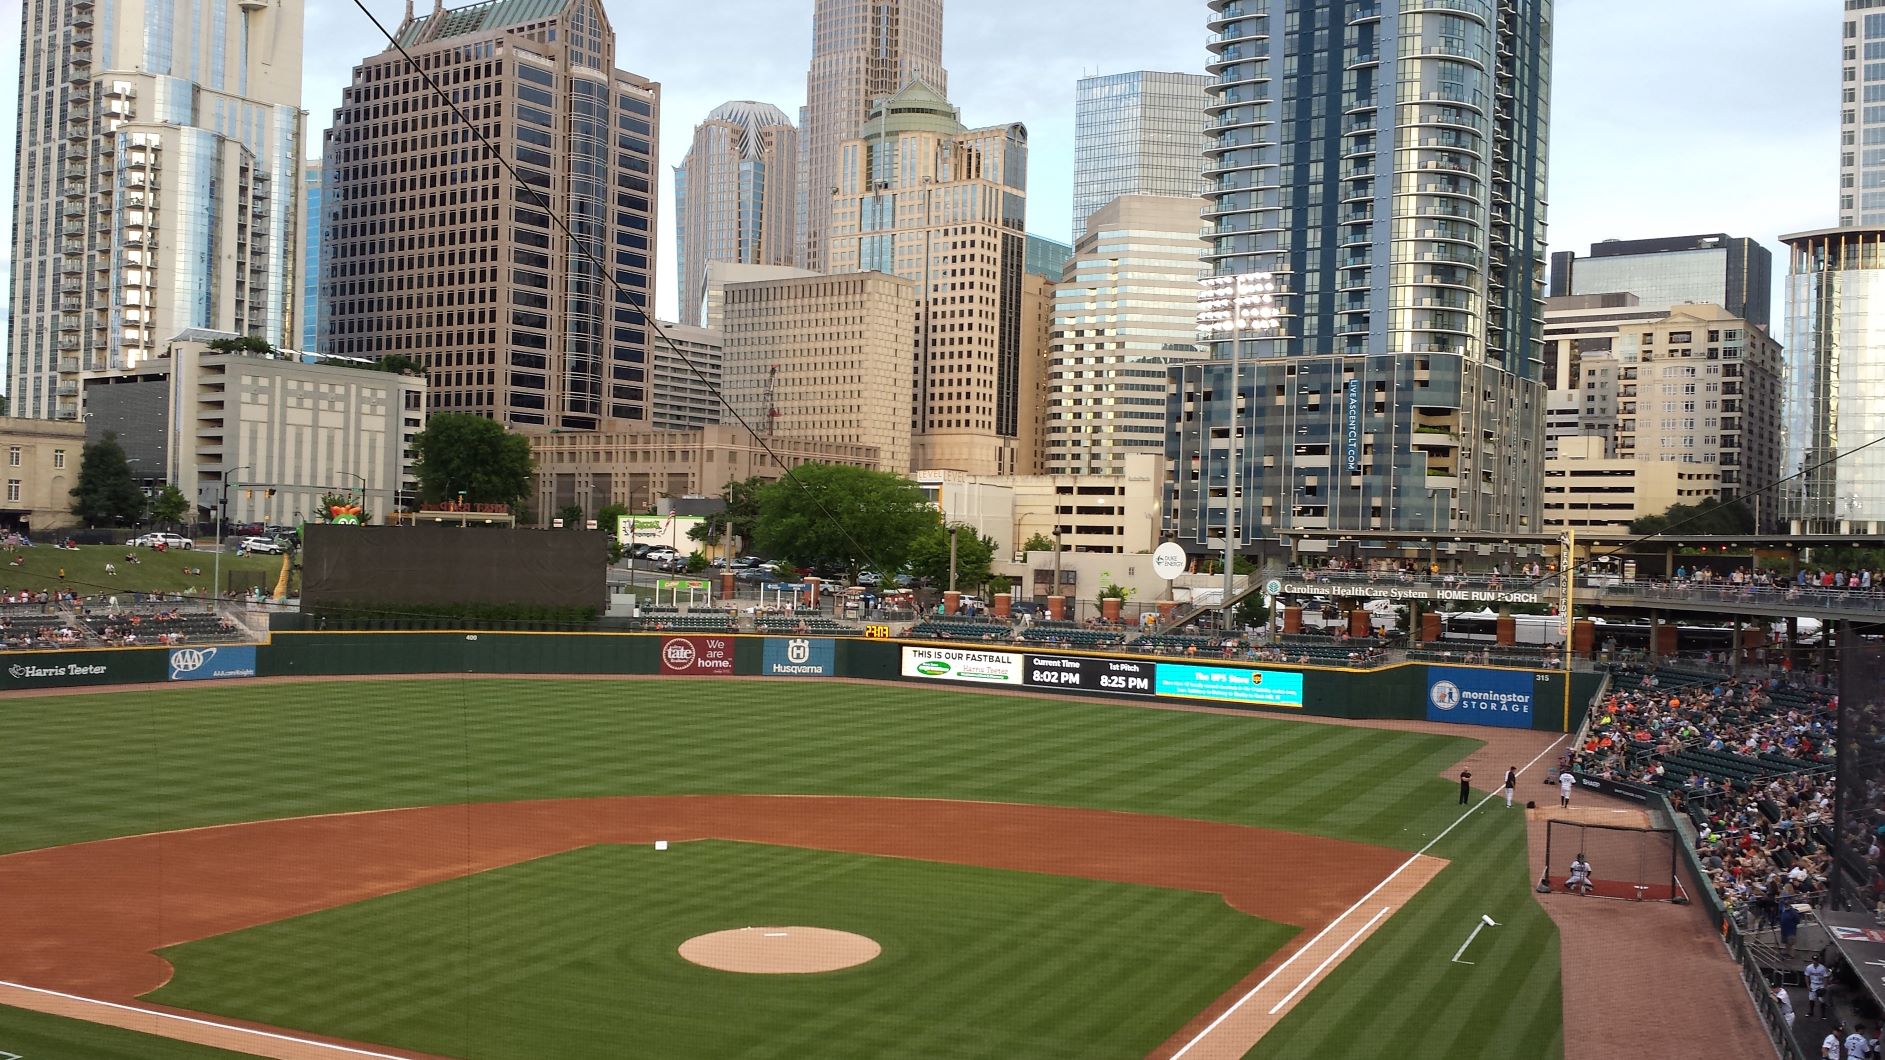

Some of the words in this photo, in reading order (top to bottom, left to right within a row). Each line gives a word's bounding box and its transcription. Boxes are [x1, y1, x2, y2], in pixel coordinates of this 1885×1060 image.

[1348, 380, 1358, 470] LIVEASCENTCLT.COM
[1284, 584, 1330, 596] Carolinas
[1332, 585, 1388, 597] HealthCare
[1390, 587, 1428, 600] System
[1437, 590, 1469, 601] HOME
[1471, 591, 1498, 602] RUN
[1499, 592, 1537, 603] PORCH
[706, 639, 725, 649] We
[667, 646, 692, 659] tate
[706, 650, 724, 659] are
[912, 649, 932, 659] THIS
[934, 651, 942, 659] IS
[944, 652, 963, 661] OUR
[965, 653, 1012, 664] FASTBALL
[174, 650, 201, 670] AAA
[698, 658, 732, 668] home.
[1033, 658, 1061, 668] Current
[1062, 660, 1081, 669] Time
[25, 665, 66, 678] Harris
[68, 663, 107, 676] Teeter
[773, 663, 823, 675] Husqvarna
[1109, 662, 1119, 672] 1st
[1120, 663, 1140, 673] Pitch
[1032, 670, 1059, 683] 8:02
[1061, 672, 1080, 685] PM
[1100, 675, 1126, 688] 8:25
[1128, 677, 1148, 690] PM
[1536, 674, 1550, 682] 315
[1462, 690, 1530, 704] morningstar
[1462, 701, 1529, 713] STORAGE
